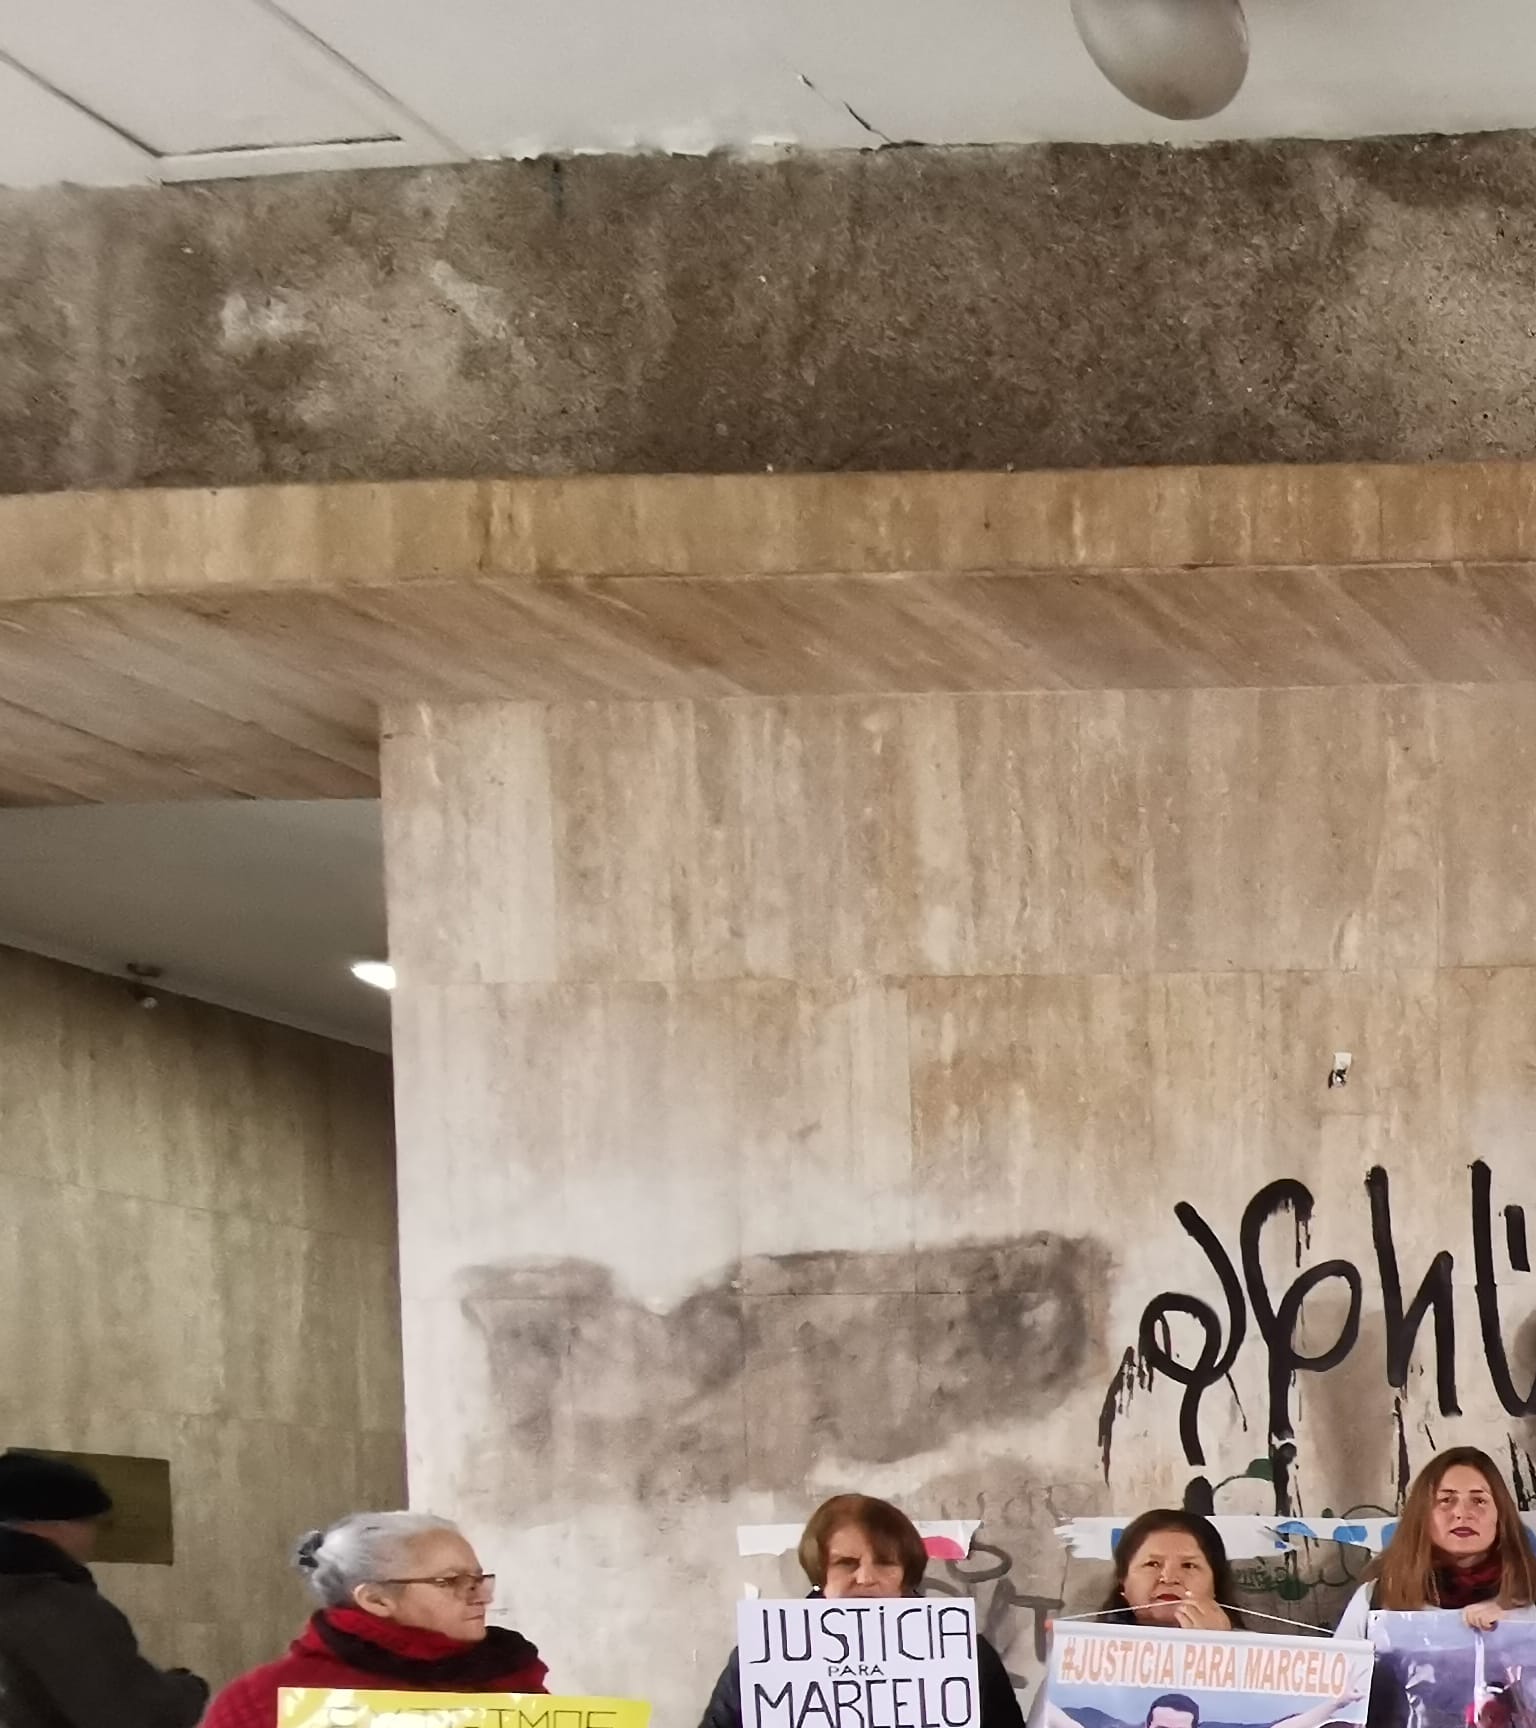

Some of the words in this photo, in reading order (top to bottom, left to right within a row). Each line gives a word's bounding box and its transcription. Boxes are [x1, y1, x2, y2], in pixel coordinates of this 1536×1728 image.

[828, 1664, 884, 1677] PARA
[1059, 1636, 1176, 1687] #JUSTICIA
[1182, 1641, 1237, 1690] PARA
[1243, 1646, 1346, 1696] MARCELO
